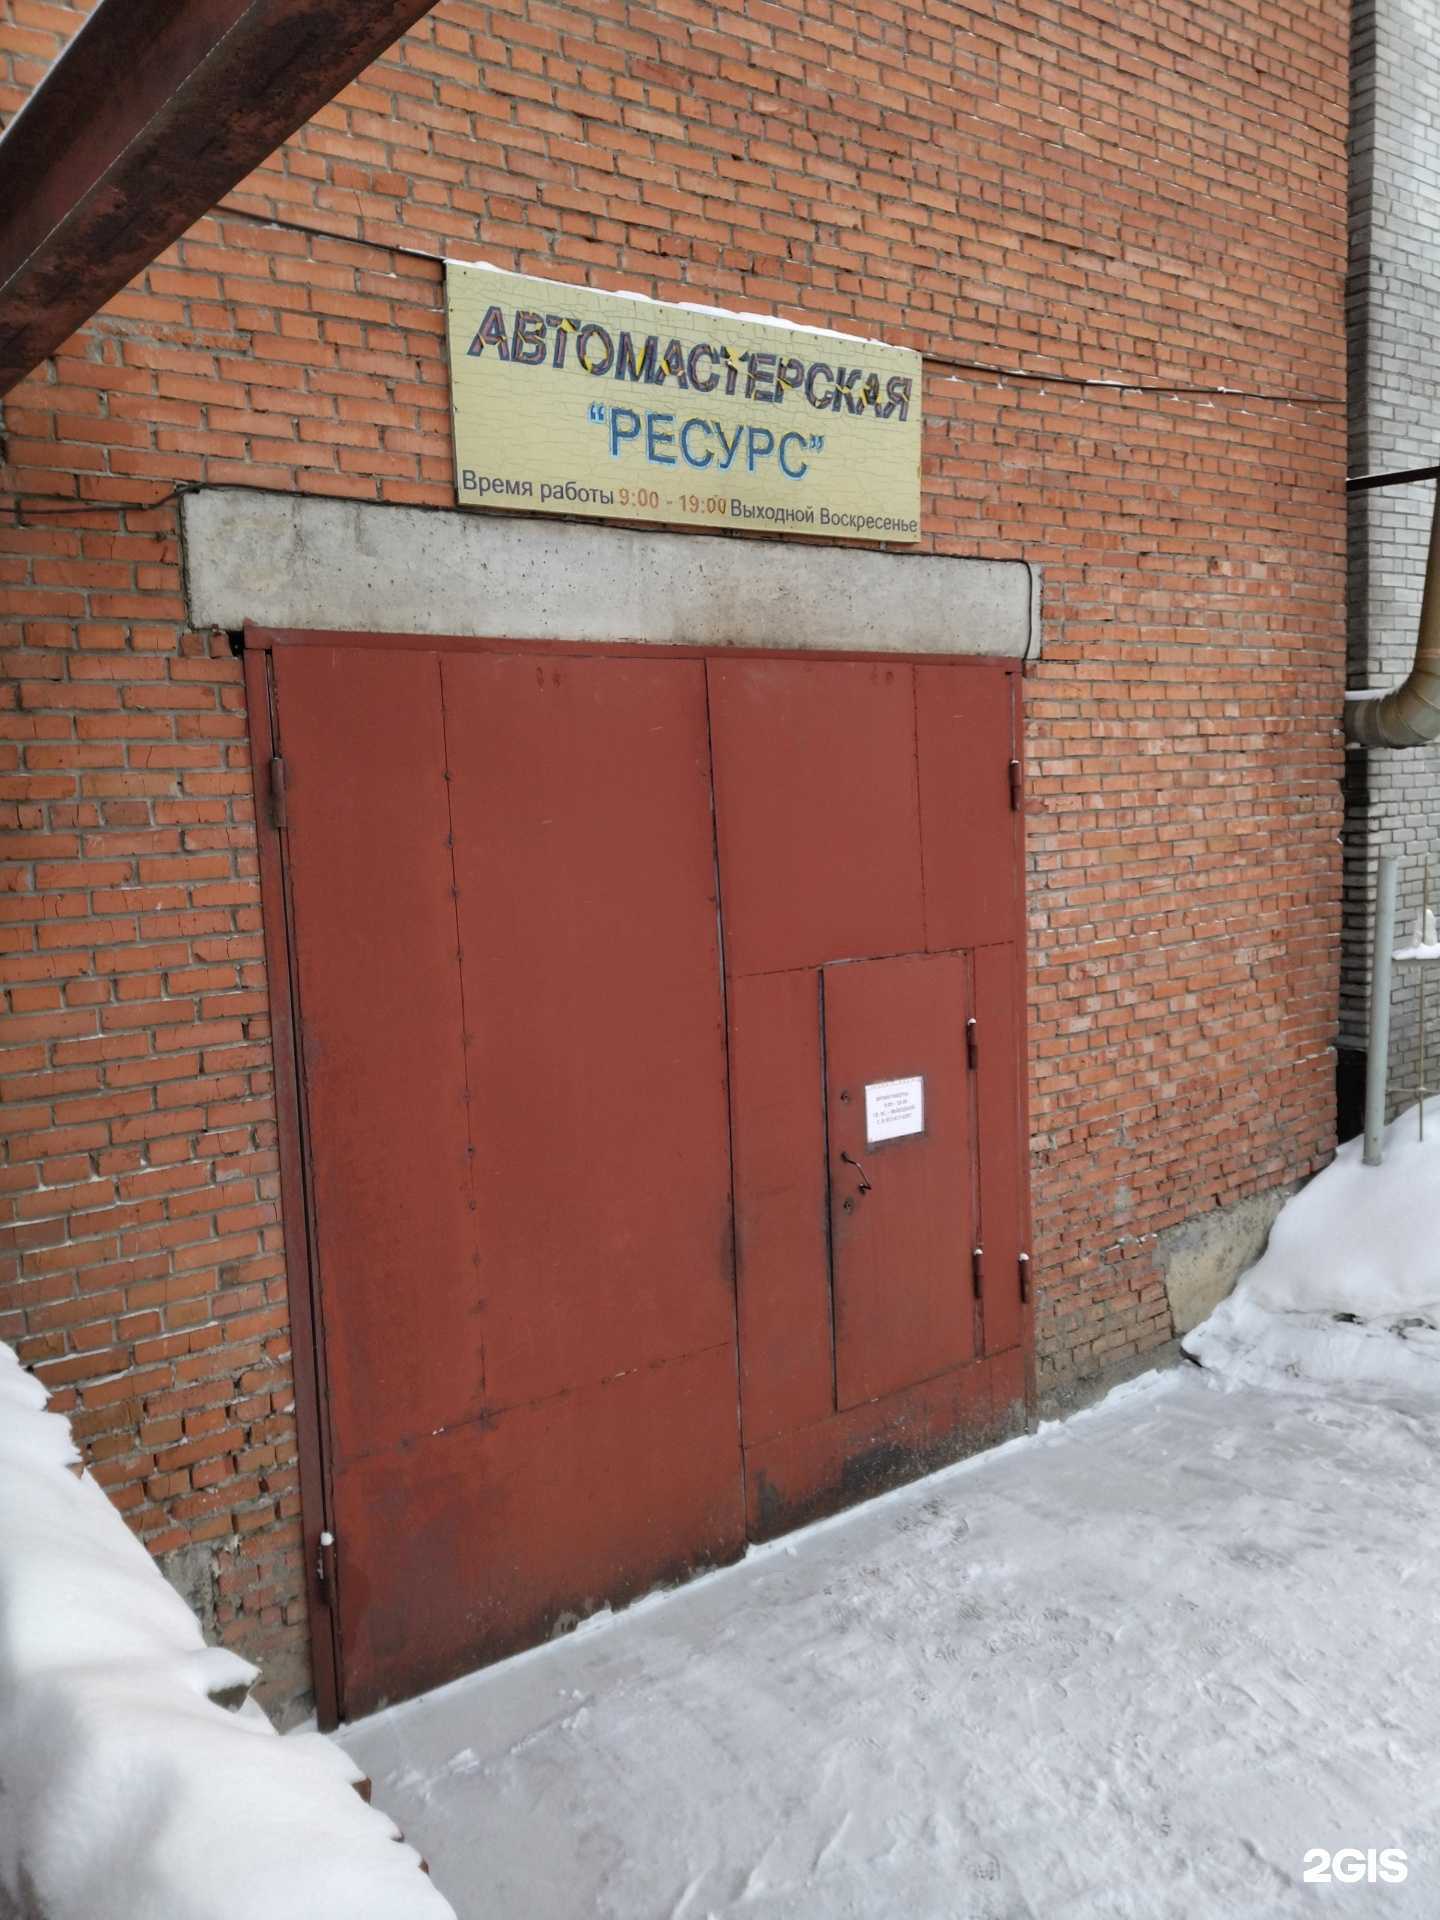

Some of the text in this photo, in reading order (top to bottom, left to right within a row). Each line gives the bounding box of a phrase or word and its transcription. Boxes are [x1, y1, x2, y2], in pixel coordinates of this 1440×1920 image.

[467, 306, 912, 421] АВТОМАСТЕРСКАЯ
[463, 469, 534, 497] Время
[540, 482, 614, 506] работы
[619, 489, 659, 508] 9:00
[679, 494, 727, 514] 19:00
[731, 499, 815, 524] Выходной
[820, 507, 918, 533] Воскресенье
